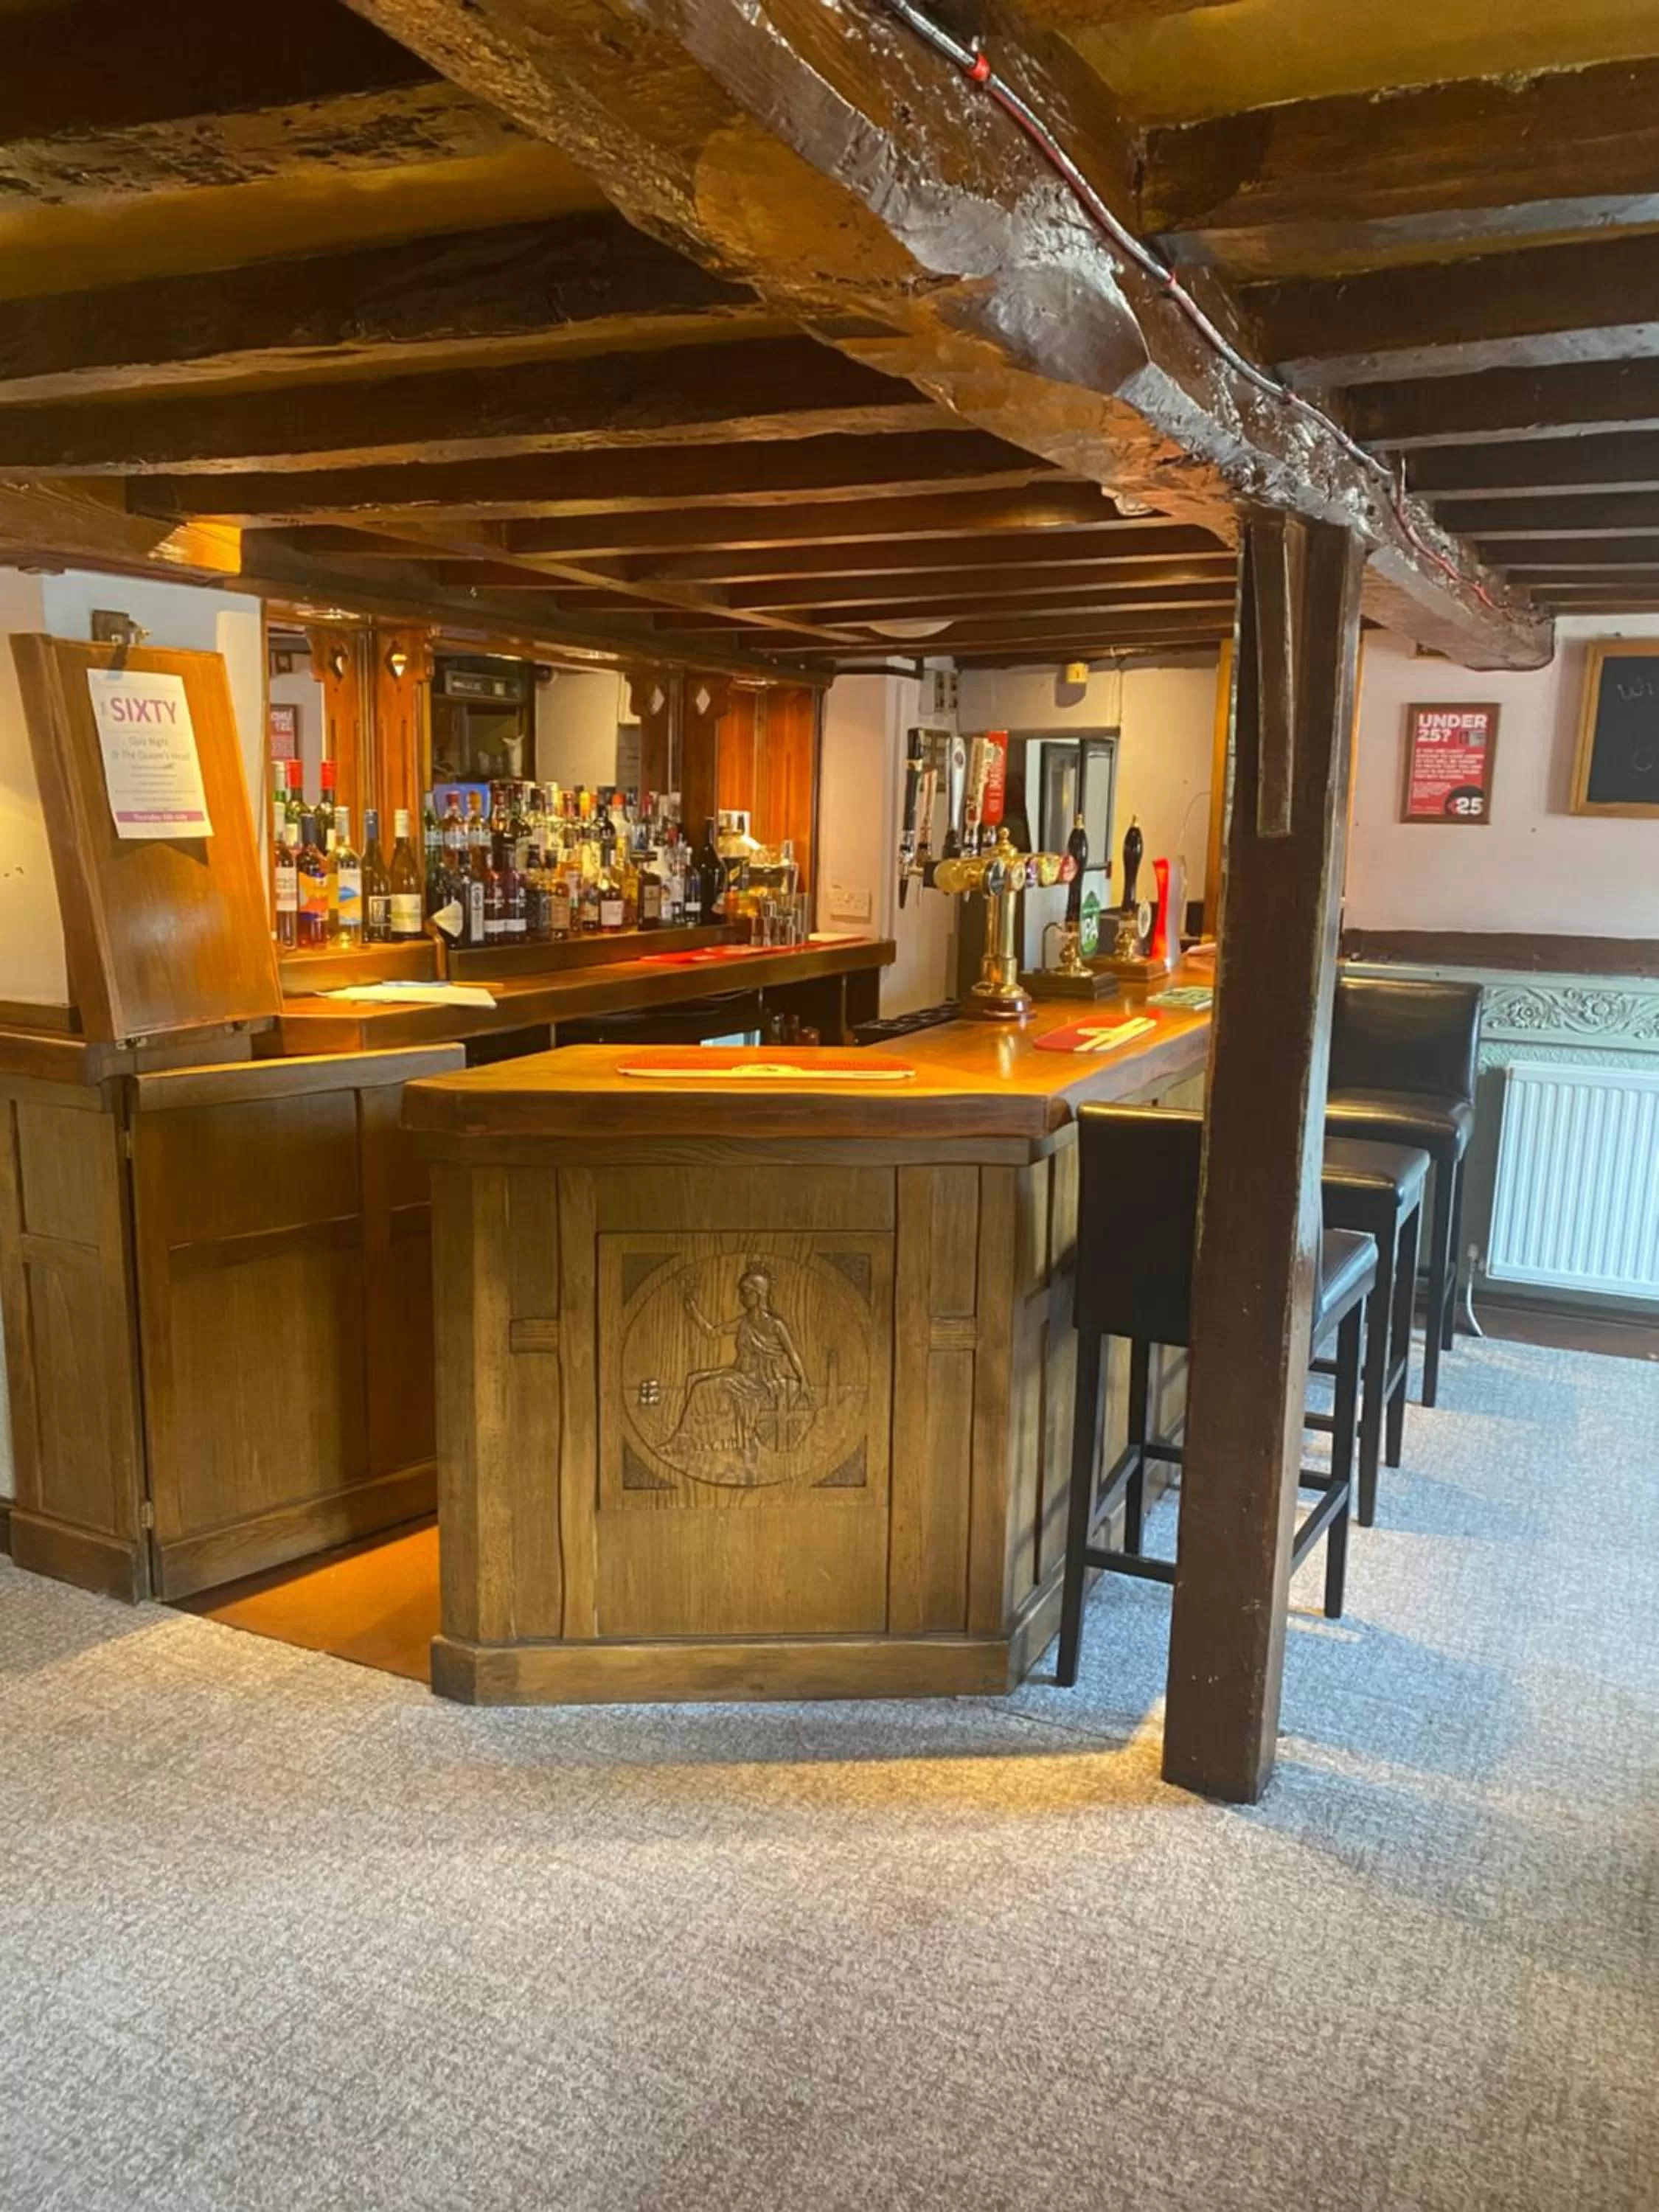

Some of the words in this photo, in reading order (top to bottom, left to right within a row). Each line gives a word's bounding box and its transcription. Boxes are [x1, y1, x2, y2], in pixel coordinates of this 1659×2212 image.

[111, 698, 176, 724] SIXTY
[1418, 714, 1487, 728] UNDER
[1417, 728, 1451, 742] 25?
[1456, 797, 1483, 815] 25
